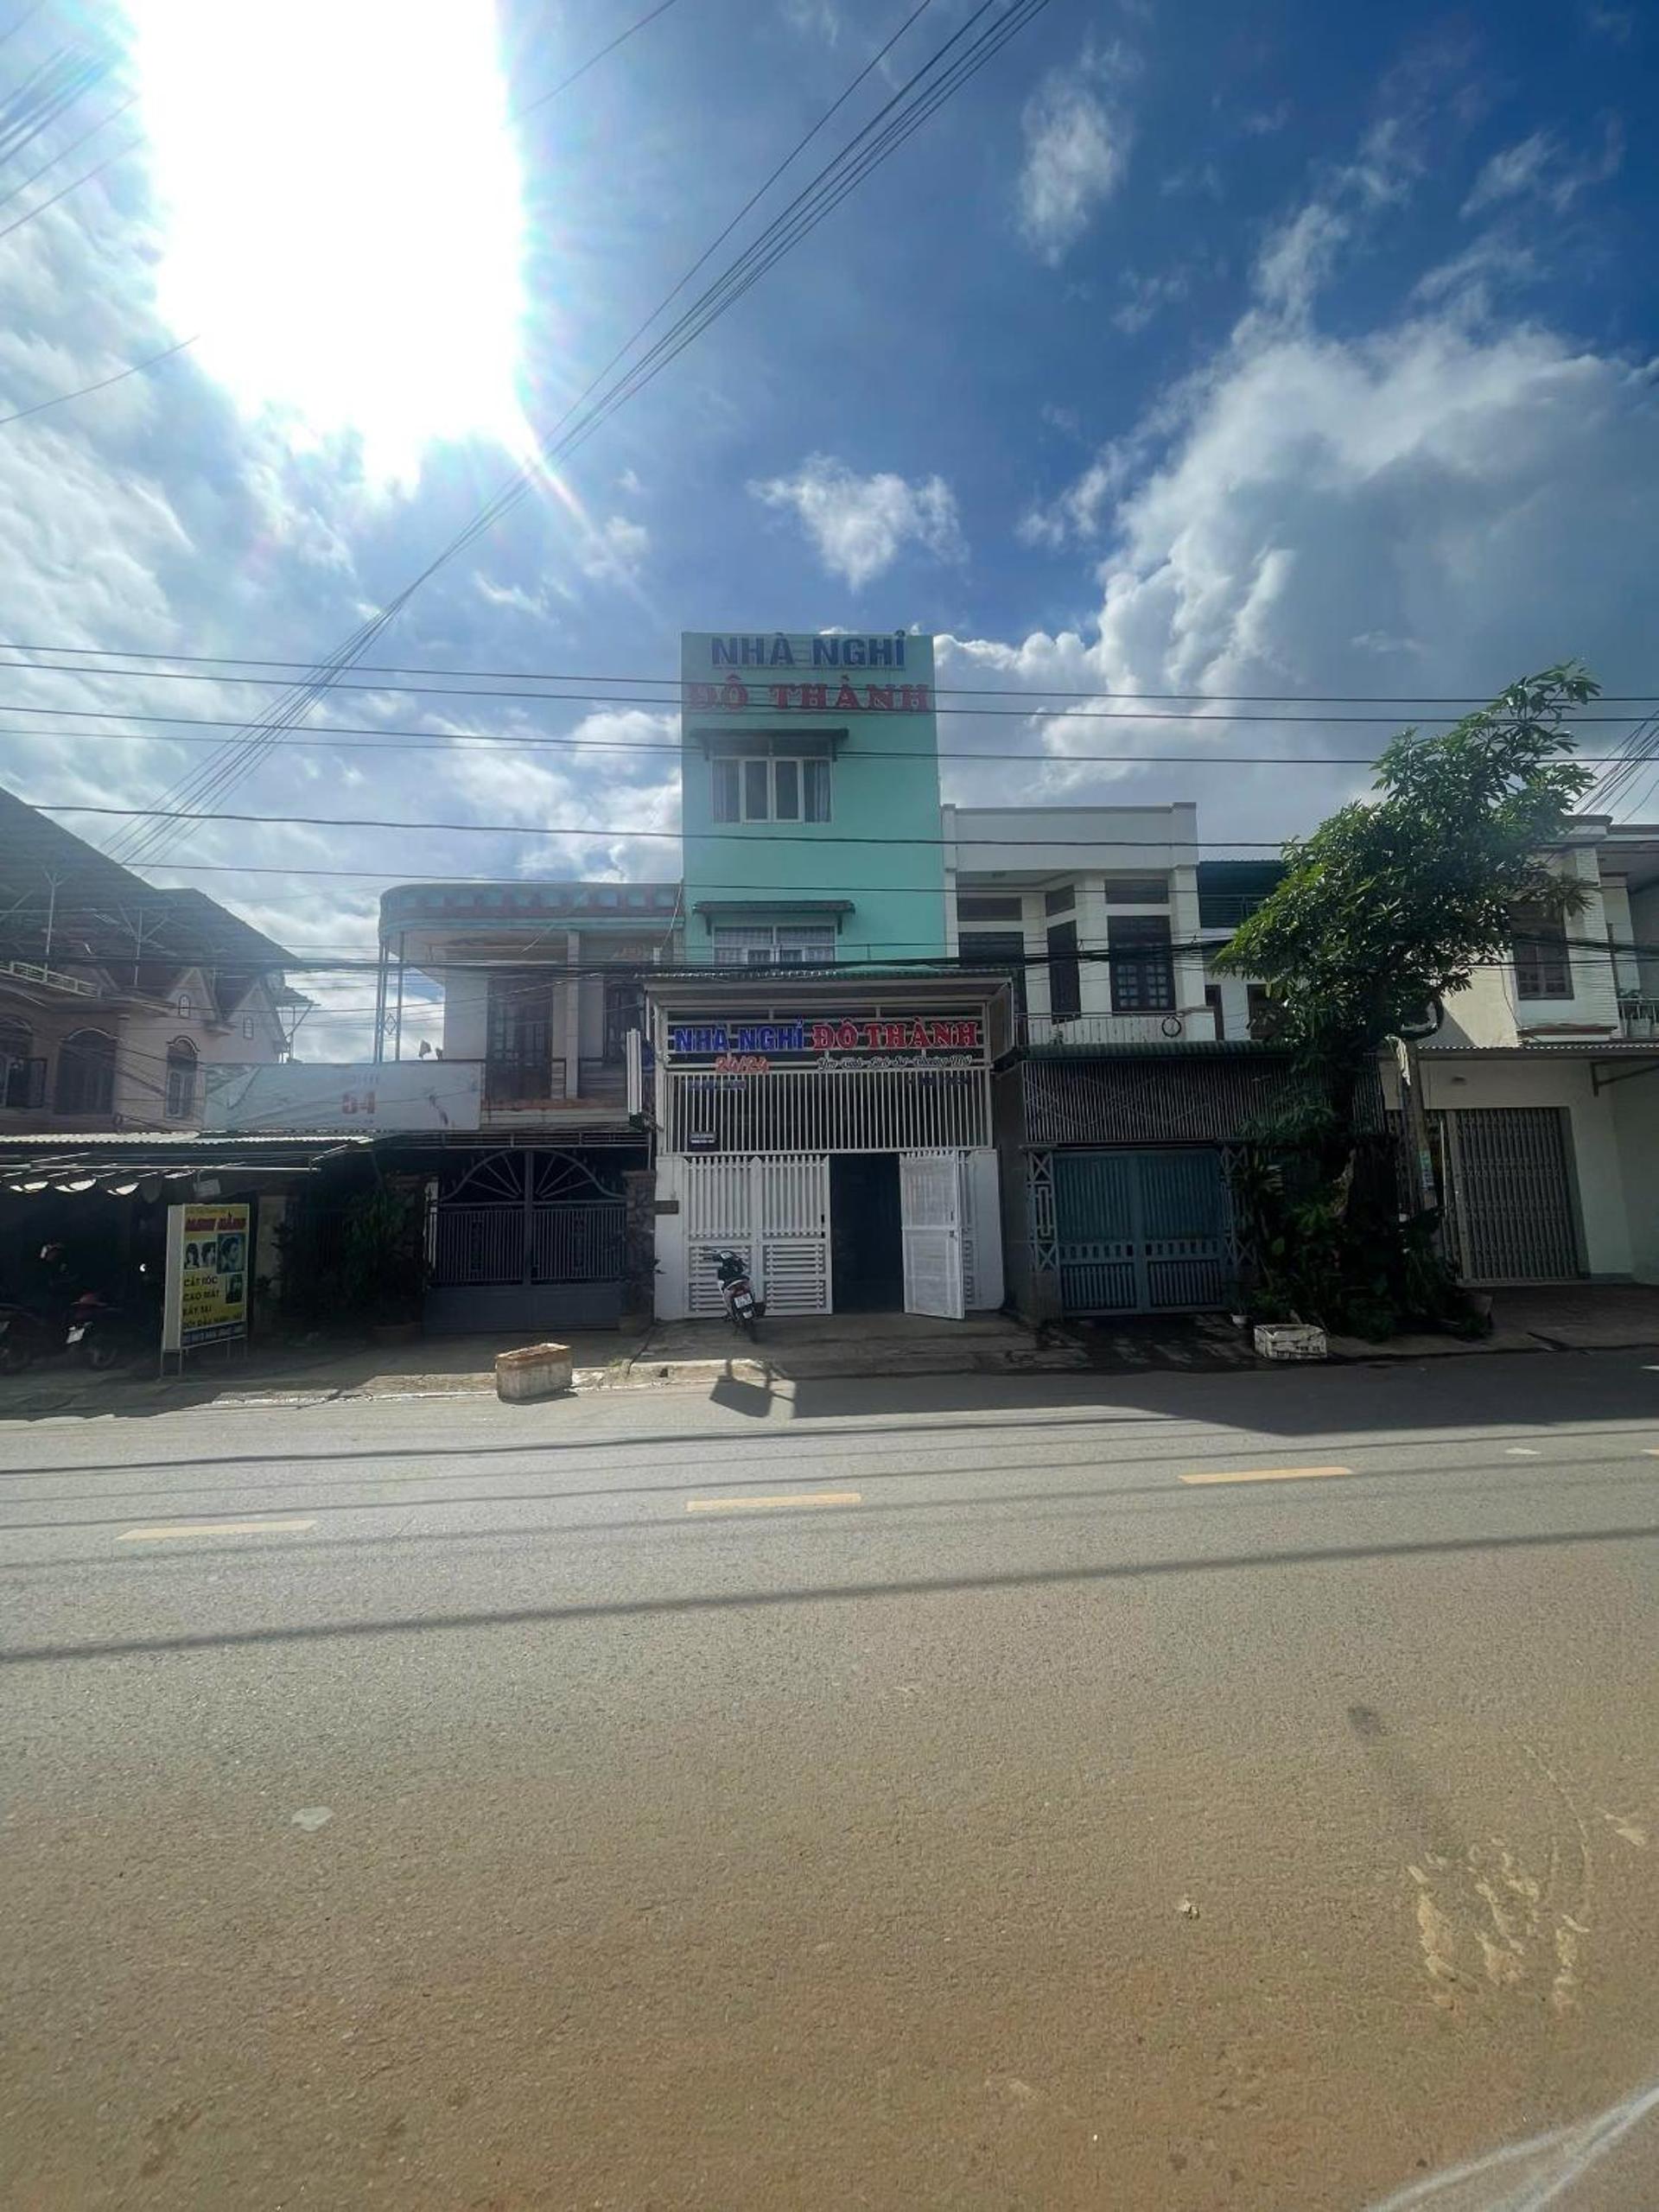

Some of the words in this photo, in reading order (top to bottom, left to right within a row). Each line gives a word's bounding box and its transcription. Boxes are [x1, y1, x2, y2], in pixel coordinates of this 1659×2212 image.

[711, 632, 793, 666] NHÀ
[812, 630, 906, 667] NGHỈ
[685, 674, 747, 710] ĐÔ
[772, 674, 931, 712] THÀNH
[674, 1022, 729, 1052] NHÀ
[738, 1016, 804, 1052] NGHỈ
[811, 1018, 859, 1050] ĐÔ
[865, 1016, 977, 1049] THÀNH
